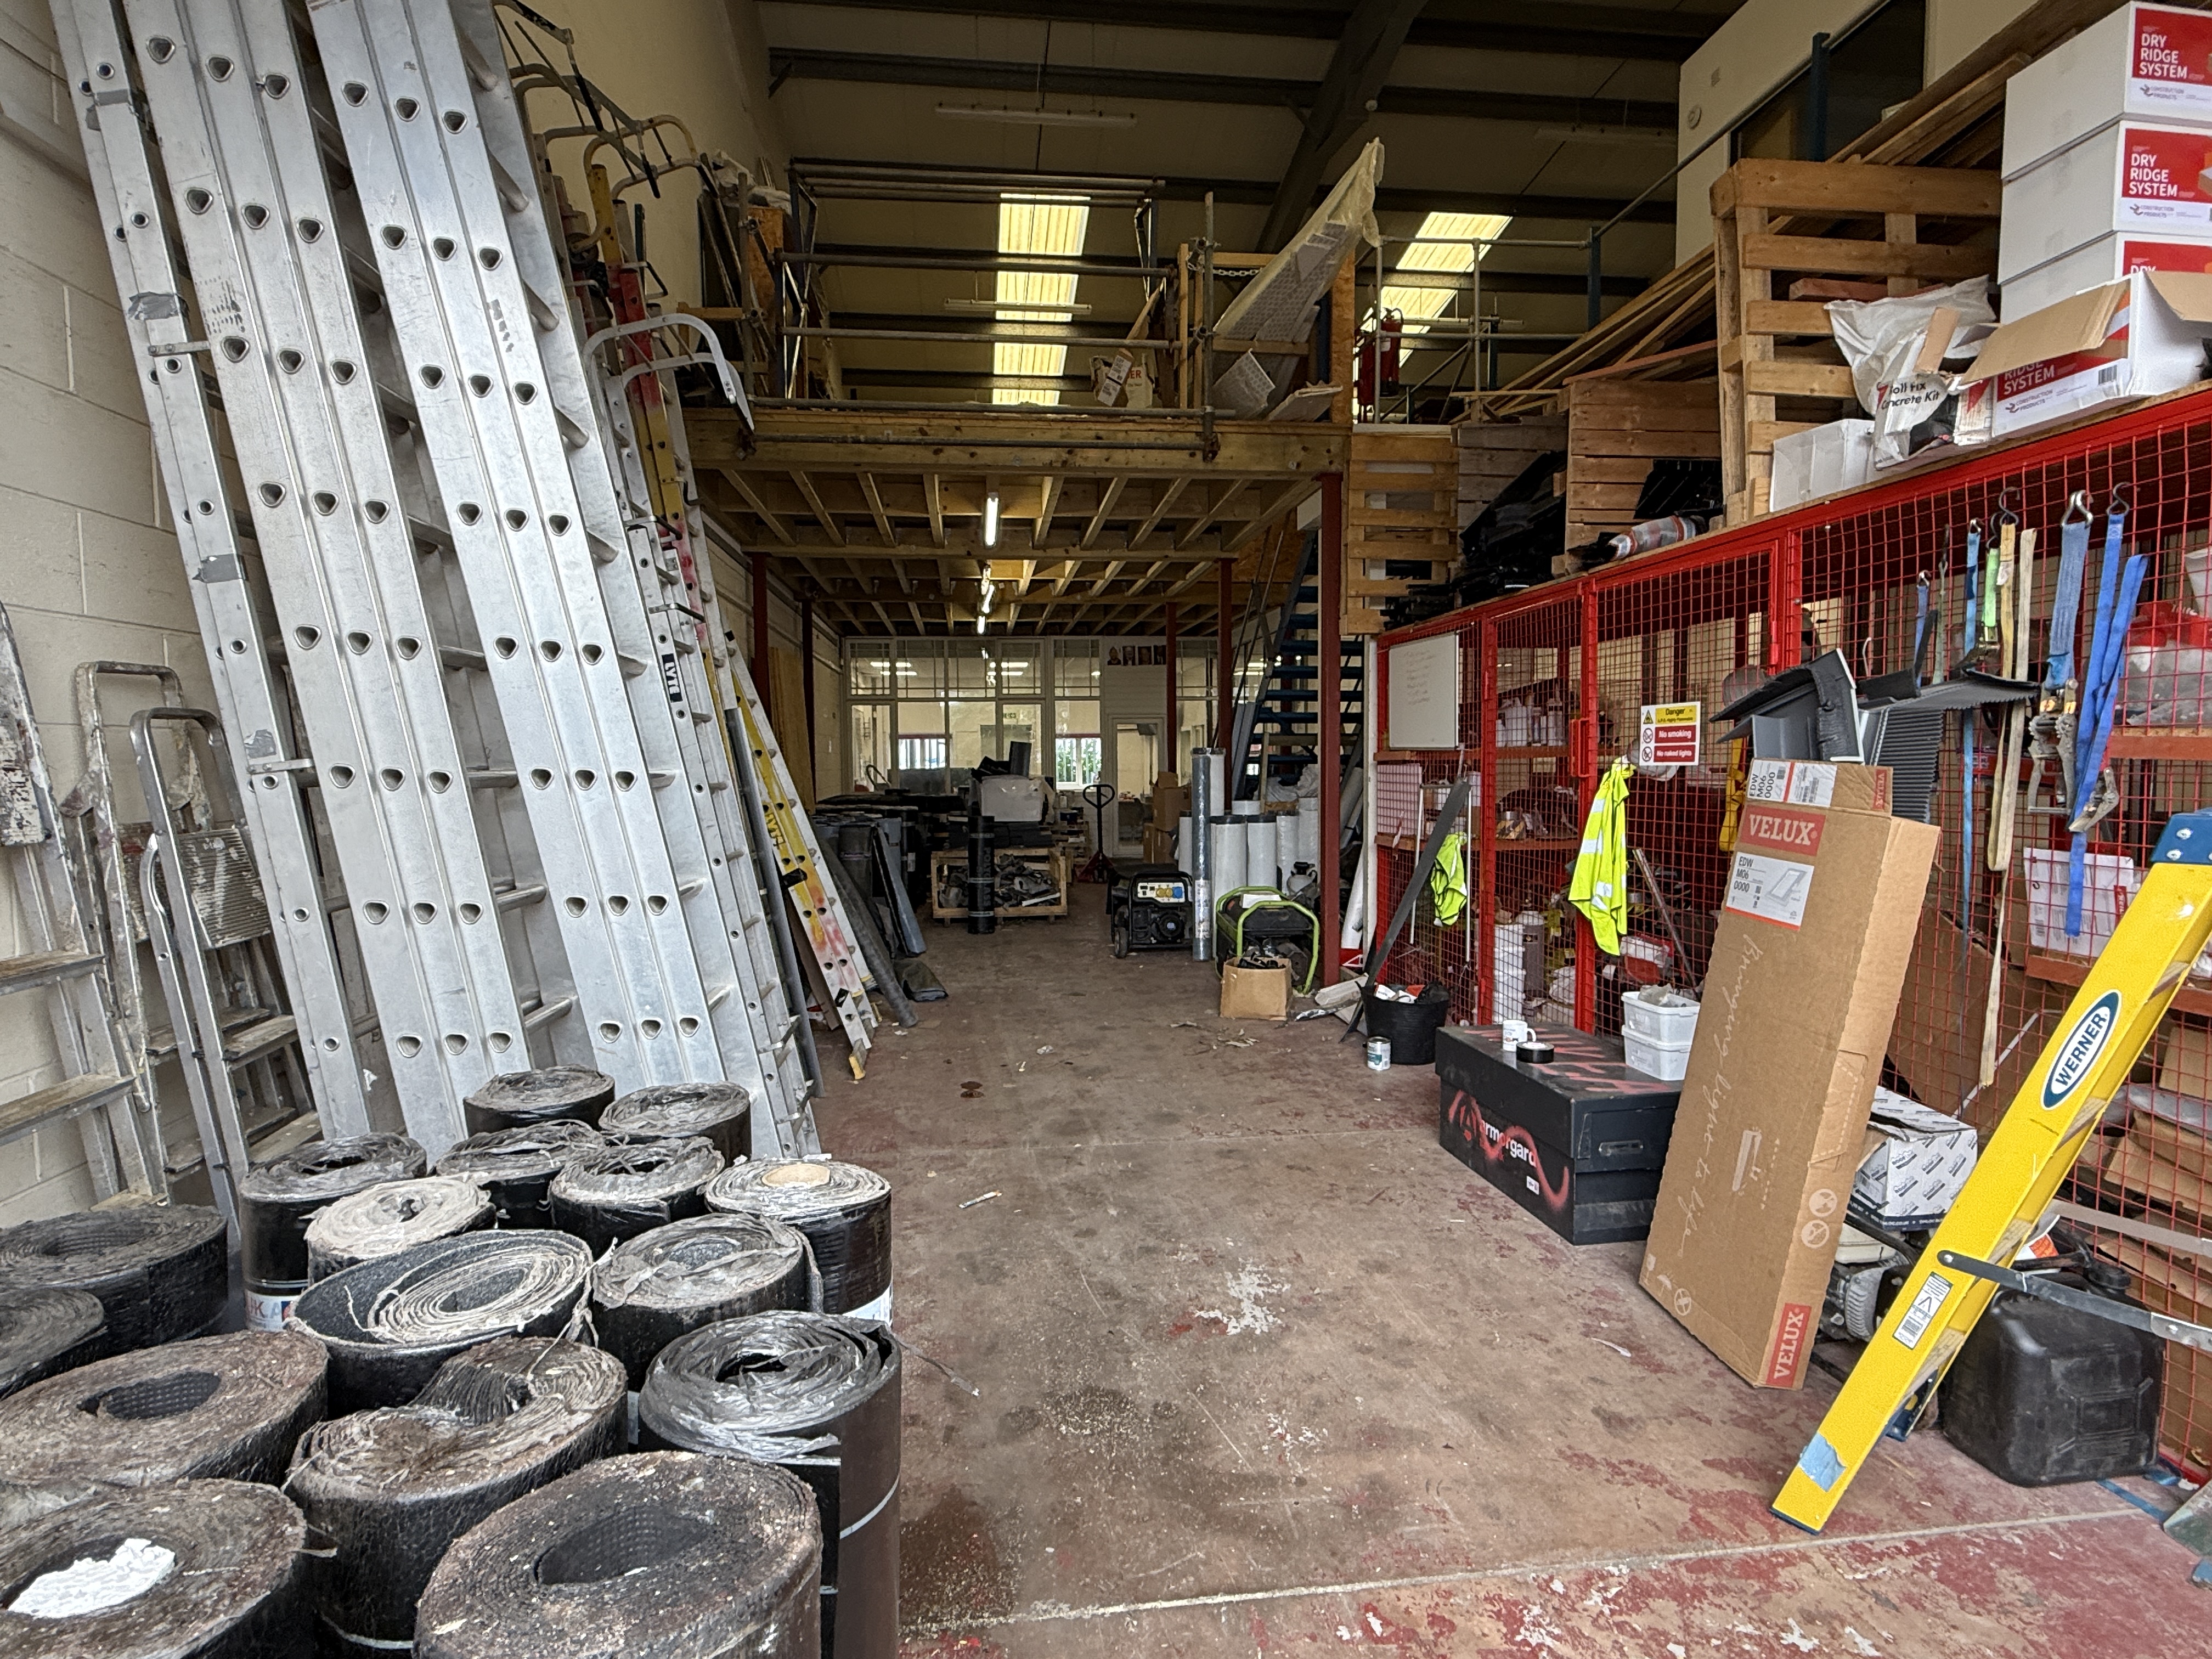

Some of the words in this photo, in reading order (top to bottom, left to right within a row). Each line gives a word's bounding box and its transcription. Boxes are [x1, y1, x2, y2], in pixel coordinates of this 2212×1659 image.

[2141, 33, 2167, 48] DRY
[2141, 48, 2179, 64] RIDGE
[2139, 62, 2187, 79] SYSTEM
[2131, 154, 2157, 167] DRY
[2130, 168, 2169, 182] RIDGE
[2129, 182, 2178, 197] SYSTEM
[2004, 365, 2055, 395] SYSTEM
[1925, 390, 1940, 403] Kit
[2016, 389, 2053, 405] CONSTRUCTION
[2020, 398, 2046, 411] PRODUCTS
[665, 662, 680, 694] LYTE
[1666, 708, 1685, 716] Danger
[1668, 730, 1692, 740] smoking
[1749, 774, 1759, 797] EDW
[1757, 775, 1767, 798] M06
[1764, 772, 1776, 798] 0000
[1749, 814, 1815, 846] VELUX
[1738, 856, 1754, 867] EDW
[1736, 868, 1749, 879] M06
[1734, 881, 1750, 893] 0000
[1713, 934, 1764, 1069] Bringing
[2054, 1013, 2107, 1088] WERNER
[1703, 1070, 1731, 1156] light
[1695, 1157, 1711, 1183] to
[1677, 1186, 1705, 1259] life
[1774, 1311, 1805, 1379] VELUX
